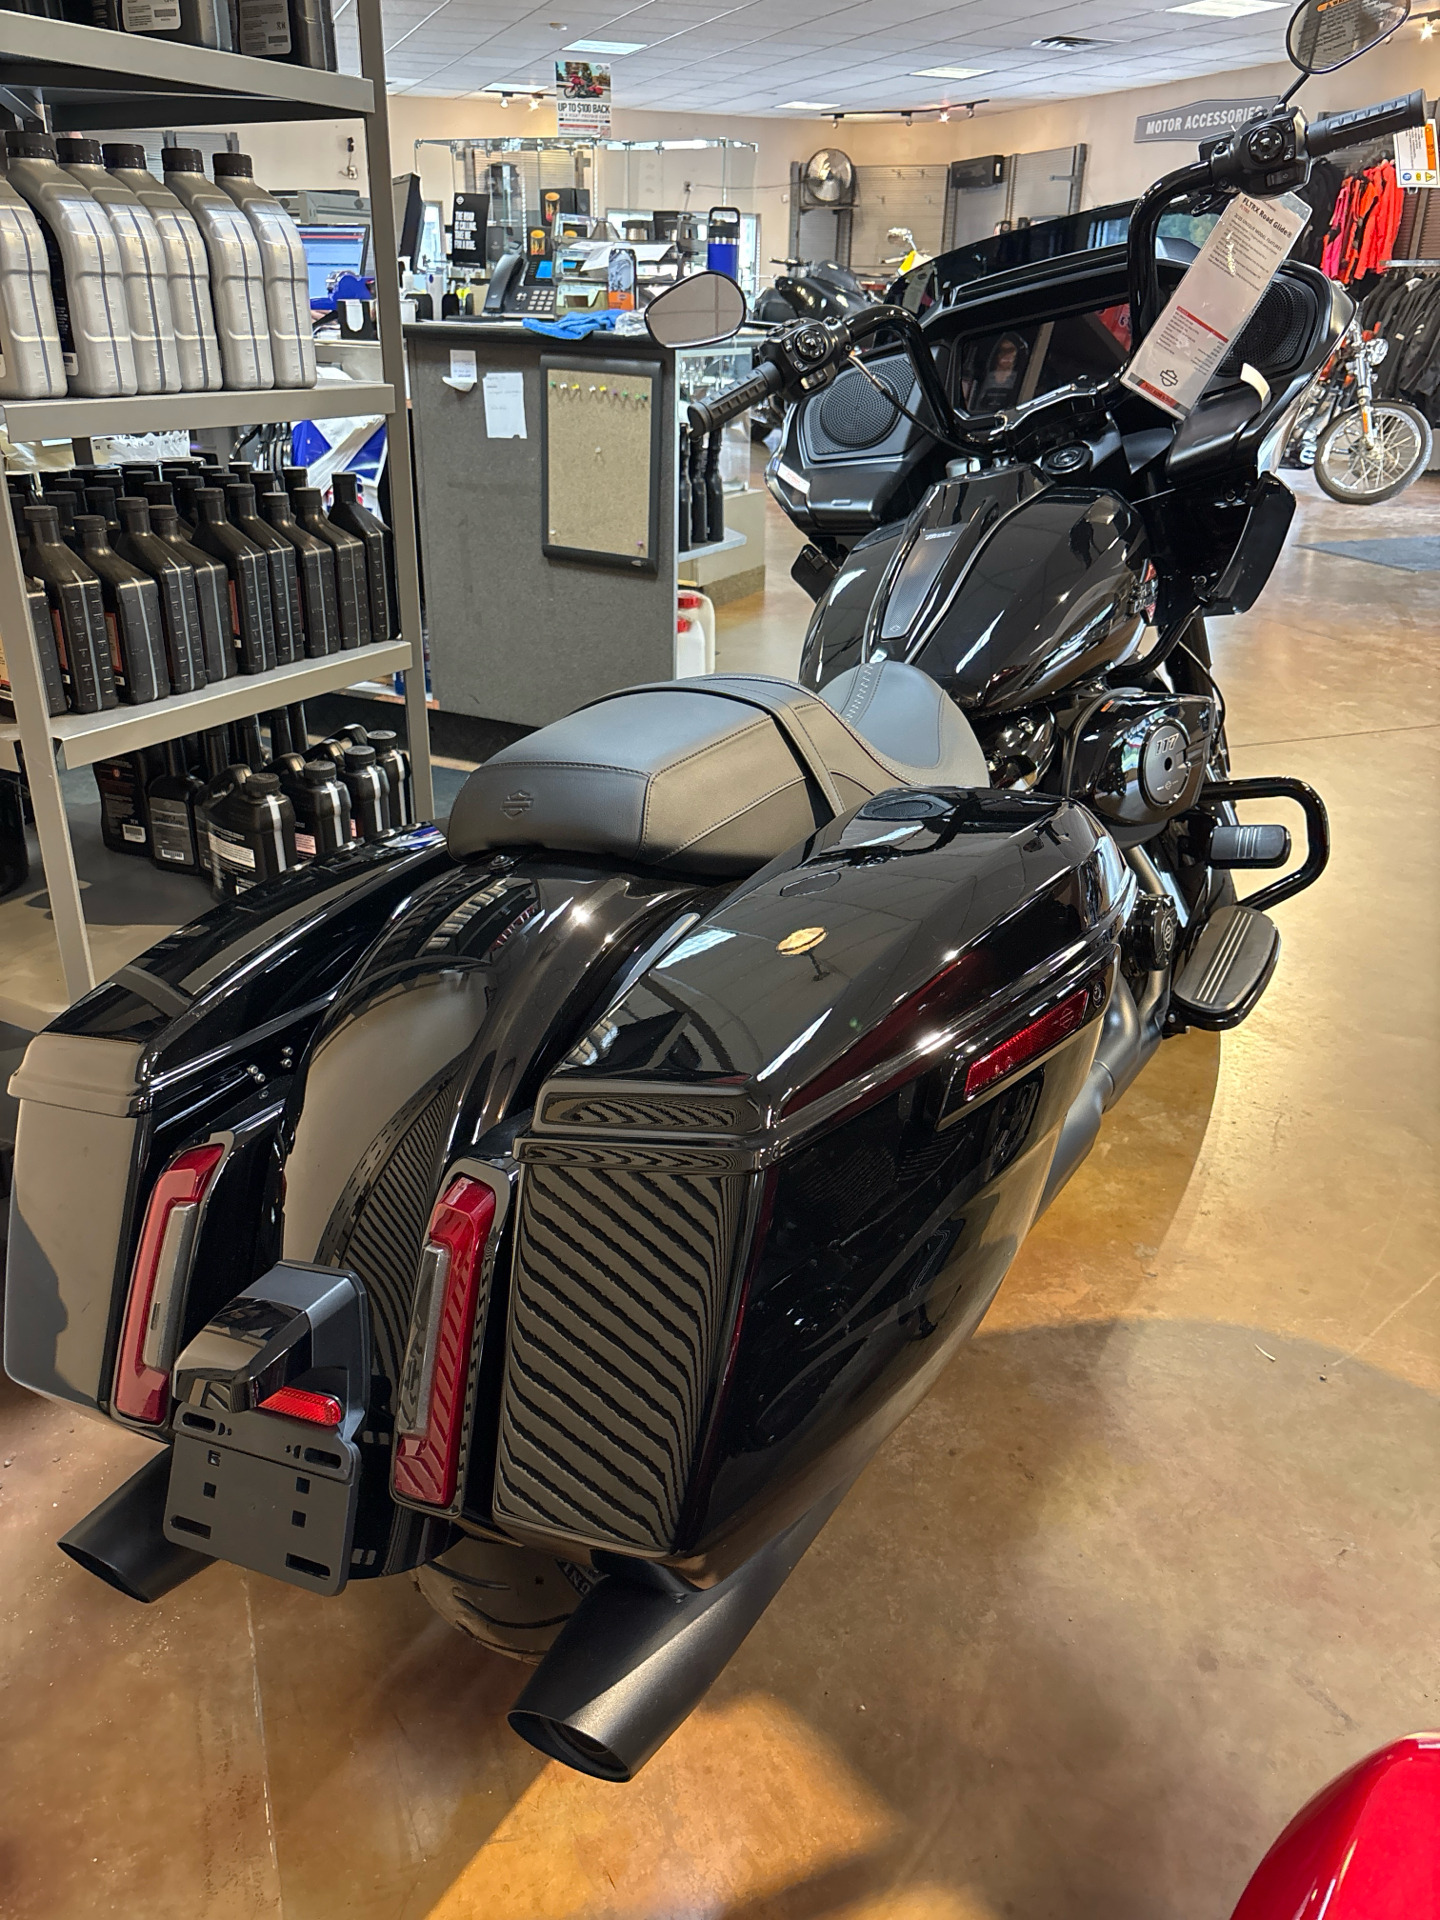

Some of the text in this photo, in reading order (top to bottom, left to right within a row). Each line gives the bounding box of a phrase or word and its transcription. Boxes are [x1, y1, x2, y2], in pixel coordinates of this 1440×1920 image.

[557, 102, 611, 114] UP TO $100 BACK
[1145, 105, 1264, 135] MOTOR ACCESSORIES
[1242, 197, 1261, 214] FLTRX
[1259, 209, 1273, 225] Road
[1156, 732, 1180, 756] 117
